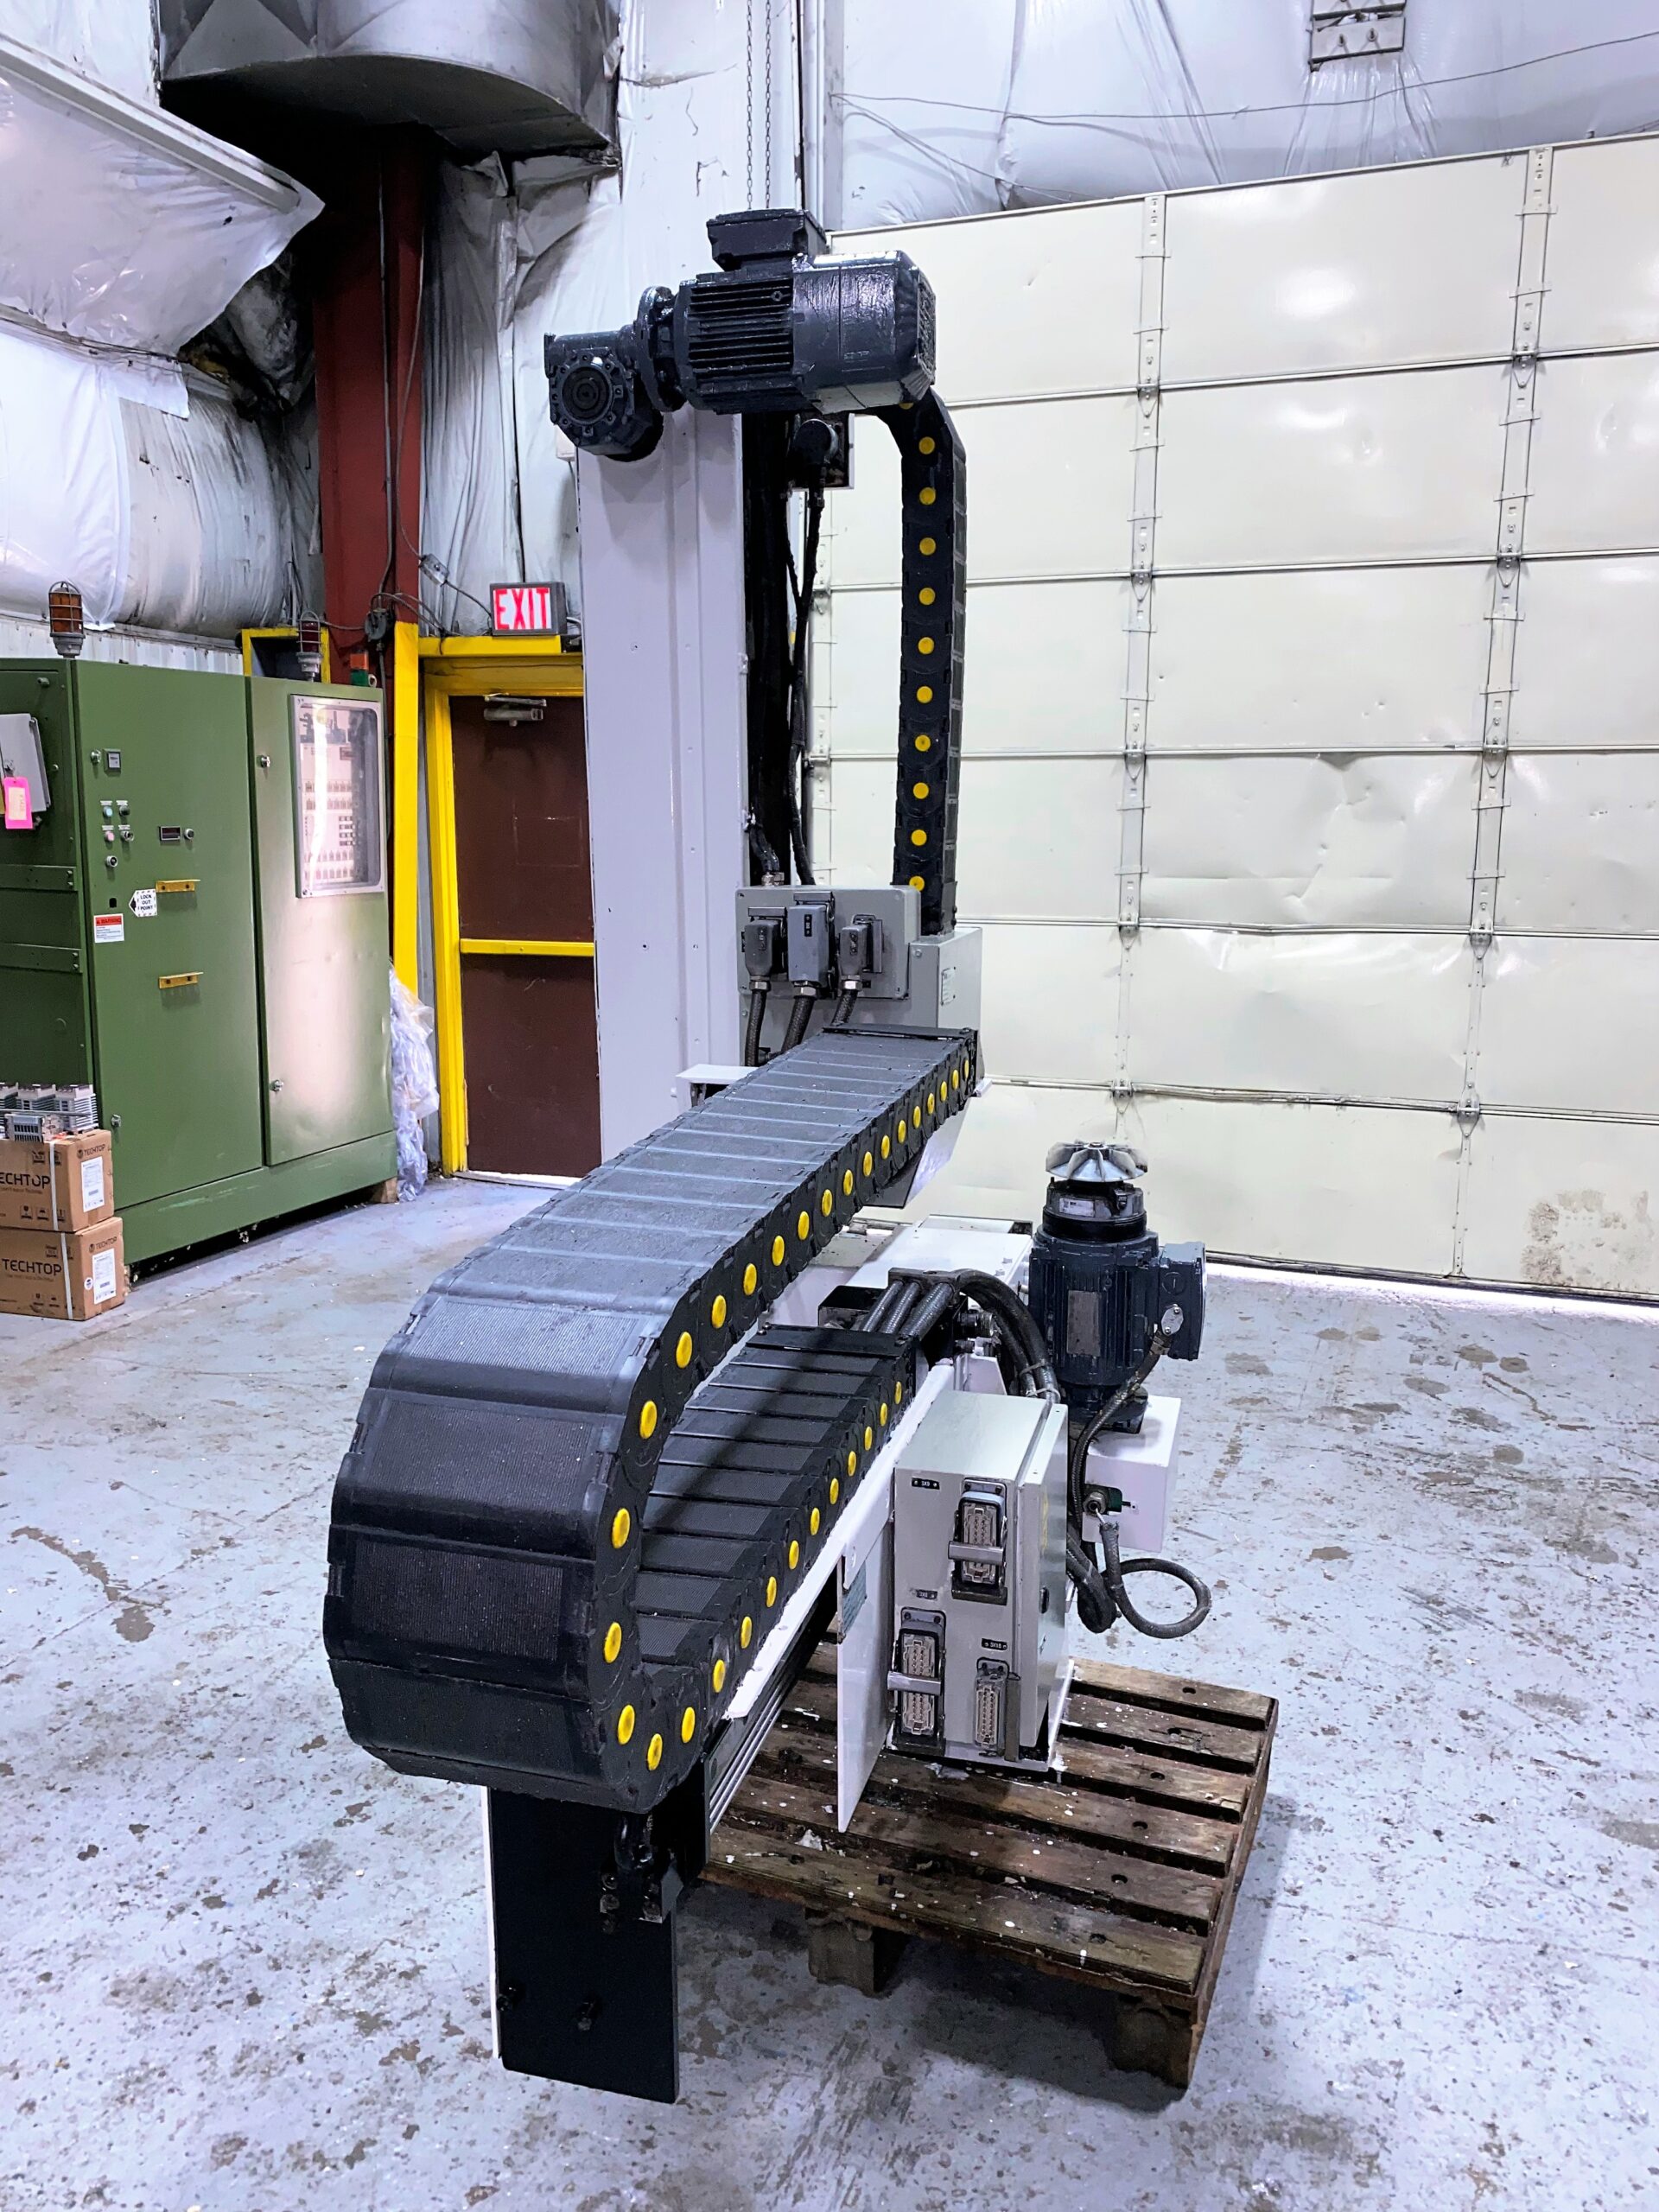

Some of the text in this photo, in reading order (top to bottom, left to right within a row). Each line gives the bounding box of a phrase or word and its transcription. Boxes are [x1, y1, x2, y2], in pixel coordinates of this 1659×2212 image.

[494, 588, 550, 630] EXIT
[84, 1144, 105, 1156] TECHTOP
[95, 1236, 118, 1249] TECHTOP
[2, 1258, 62, 1276] TECHTOP
